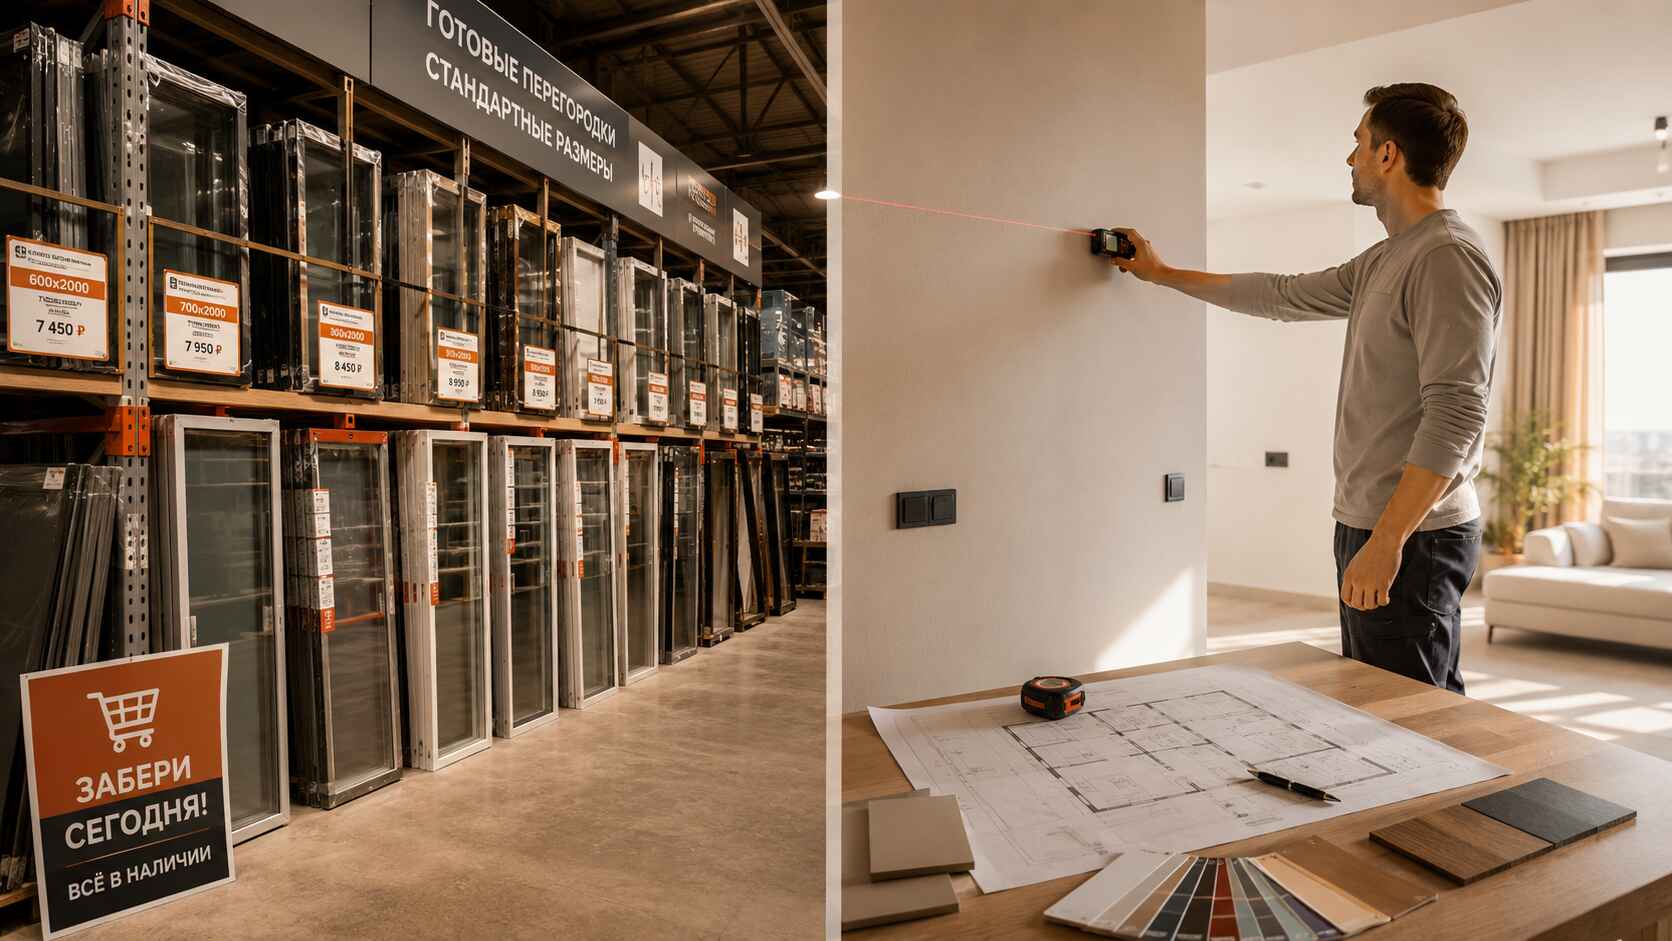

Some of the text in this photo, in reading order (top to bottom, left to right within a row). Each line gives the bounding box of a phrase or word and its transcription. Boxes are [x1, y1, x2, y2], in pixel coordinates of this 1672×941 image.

[426, 0, 616, 148] ГОТОВЫЕ ПЕРЕГОРОДКИ
[425, 52, 613, 182] СТАНДАРТНЫЕ РАЗМЕРЫ
[48, 321, 73, 336] 450
[194, 342, 214, 354] 950
[75, 755, 192, 803] ЗАБЕРИ
[65, 792, 208, 849] СЕГОДНЯ!
[68, 845, 212, 901] ВСЁ В НАЛИЧИИ
